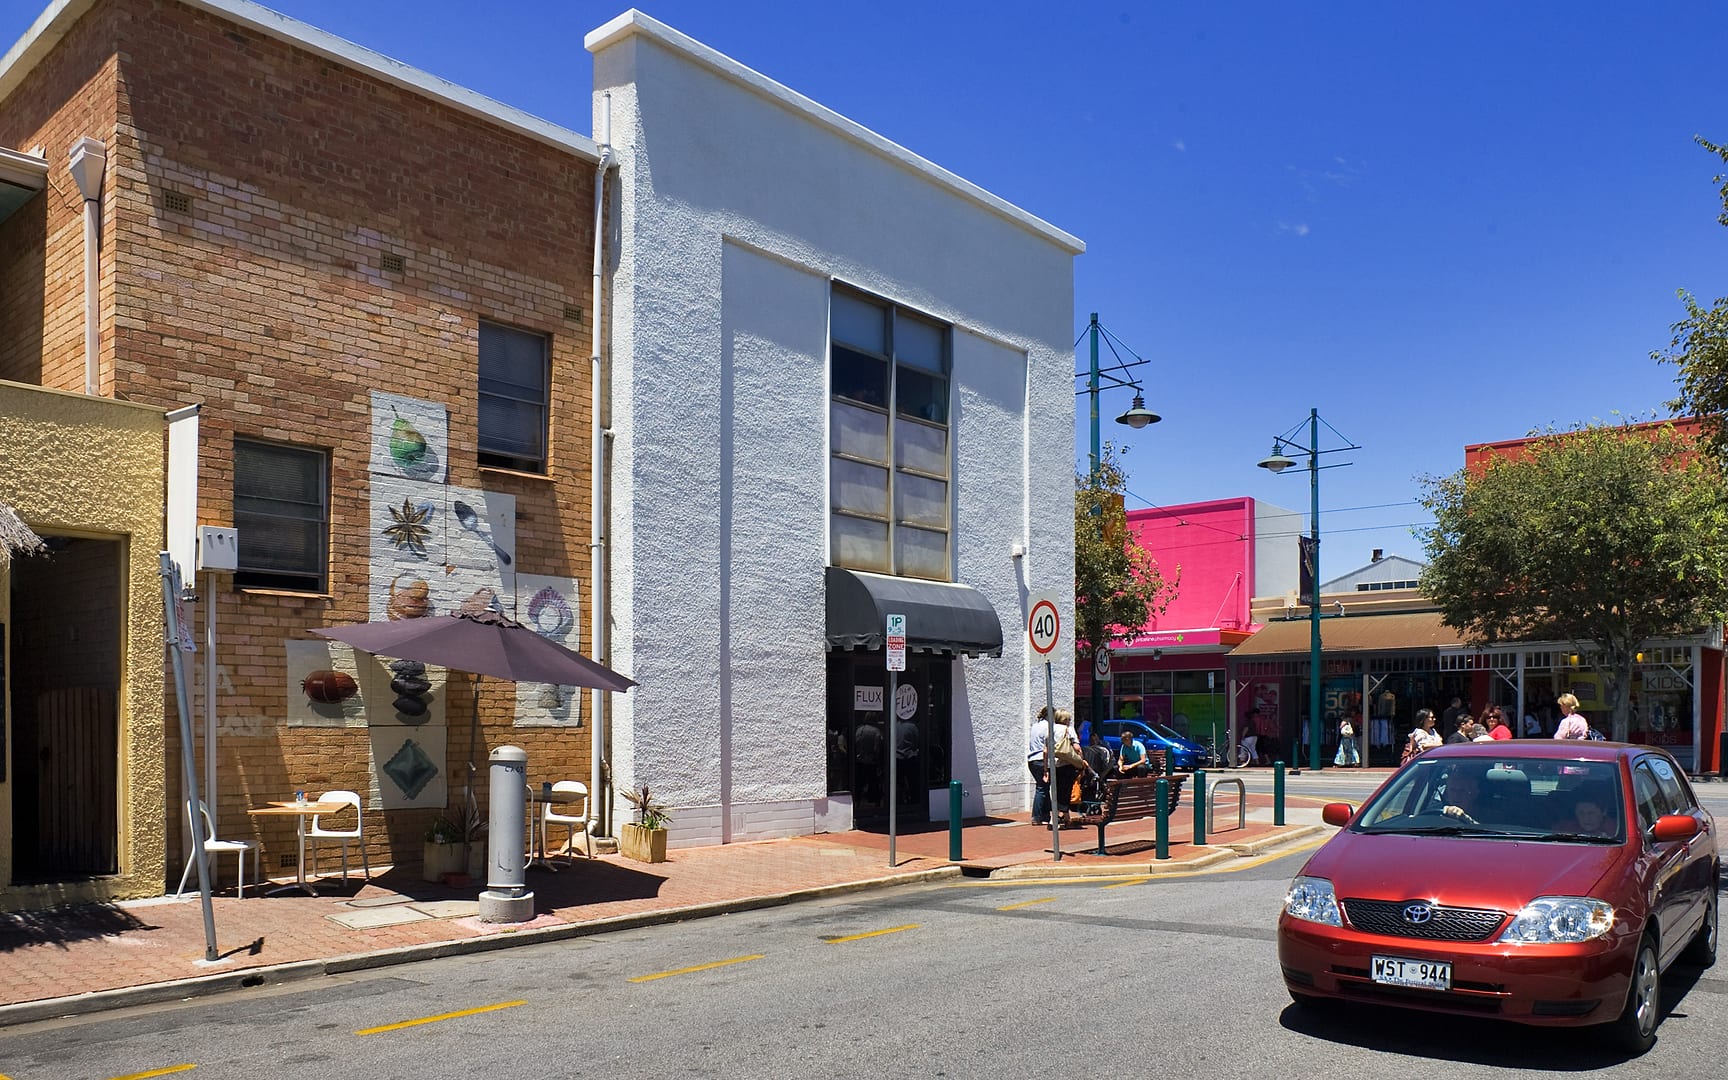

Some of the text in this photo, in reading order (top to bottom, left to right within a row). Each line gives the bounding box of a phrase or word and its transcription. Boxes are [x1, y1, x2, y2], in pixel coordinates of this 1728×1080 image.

[891, 616, 903, 627] 1P
[1034, 614, 1054, 638] 40
[1099, 652, 1108, 667] 40
[1646, 676, 1684, 689] KIDS
[856, 690, 882, 703] FLUX
[896, 693, 917, 709] FLUX
[1375, 959, 1447, 982] WST 944
